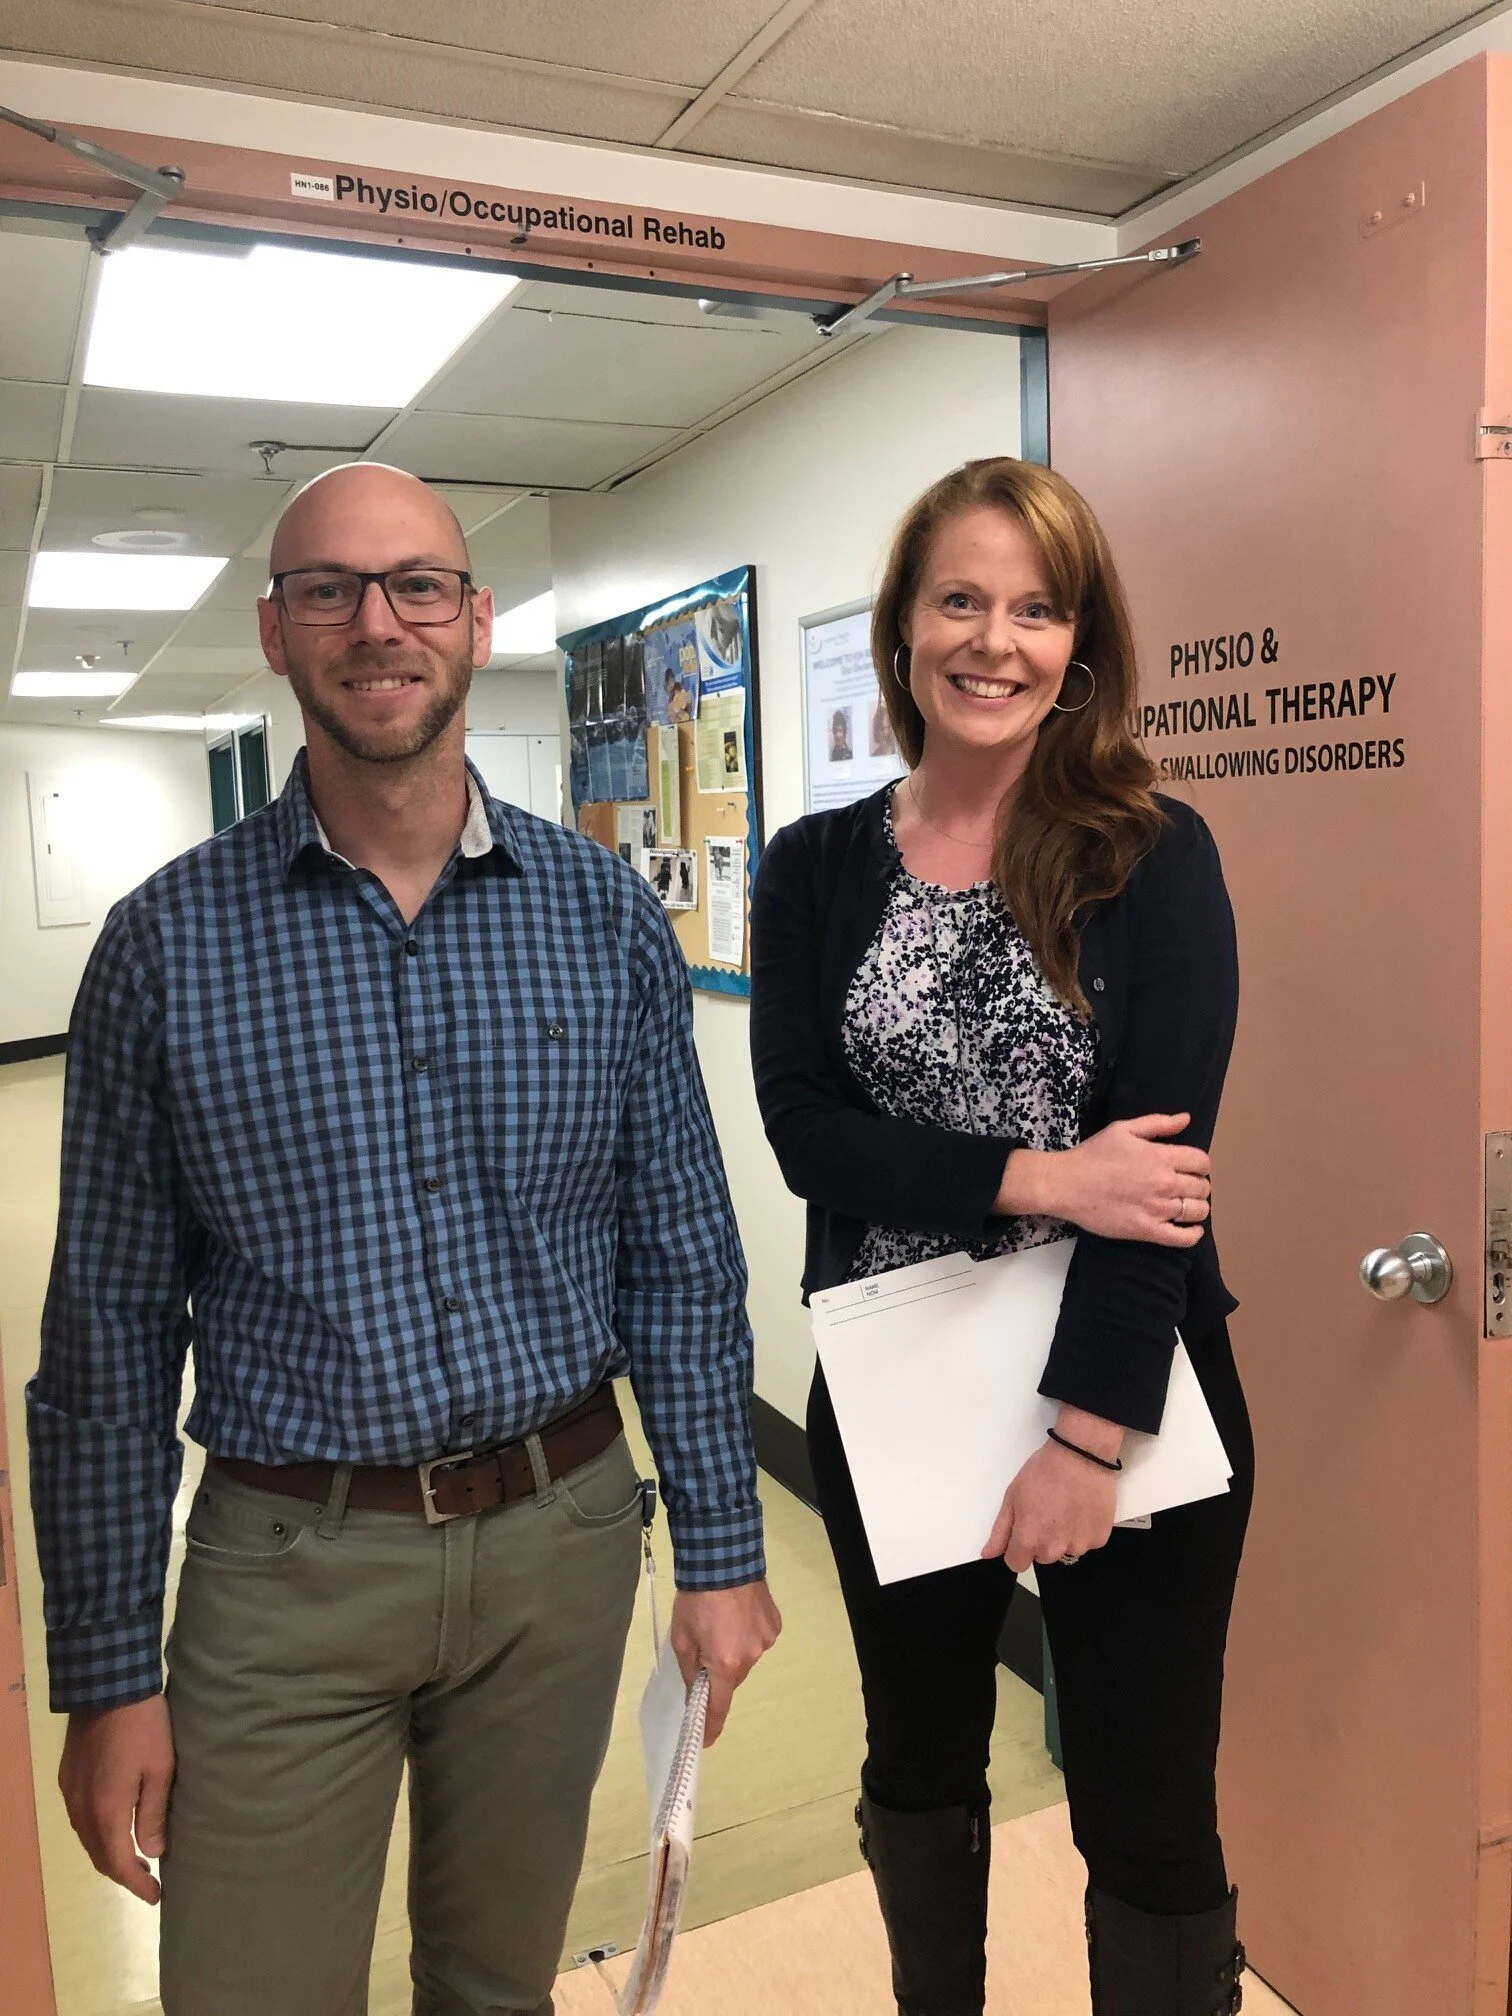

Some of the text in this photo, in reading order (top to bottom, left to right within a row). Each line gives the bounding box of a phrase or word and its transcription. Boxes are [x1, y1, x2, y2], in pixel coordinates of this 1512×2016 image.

[294, 180, 330, 192] HN1-086
[335, 174, 726, 251] Physio/Occupational Rehab
[1170, 627, 1279, 678] PHYSIO &
[1265, 673, 1397, 724] THERAPY
[1160, 738, 1405, 781] SWALLOWING DISORDERS
